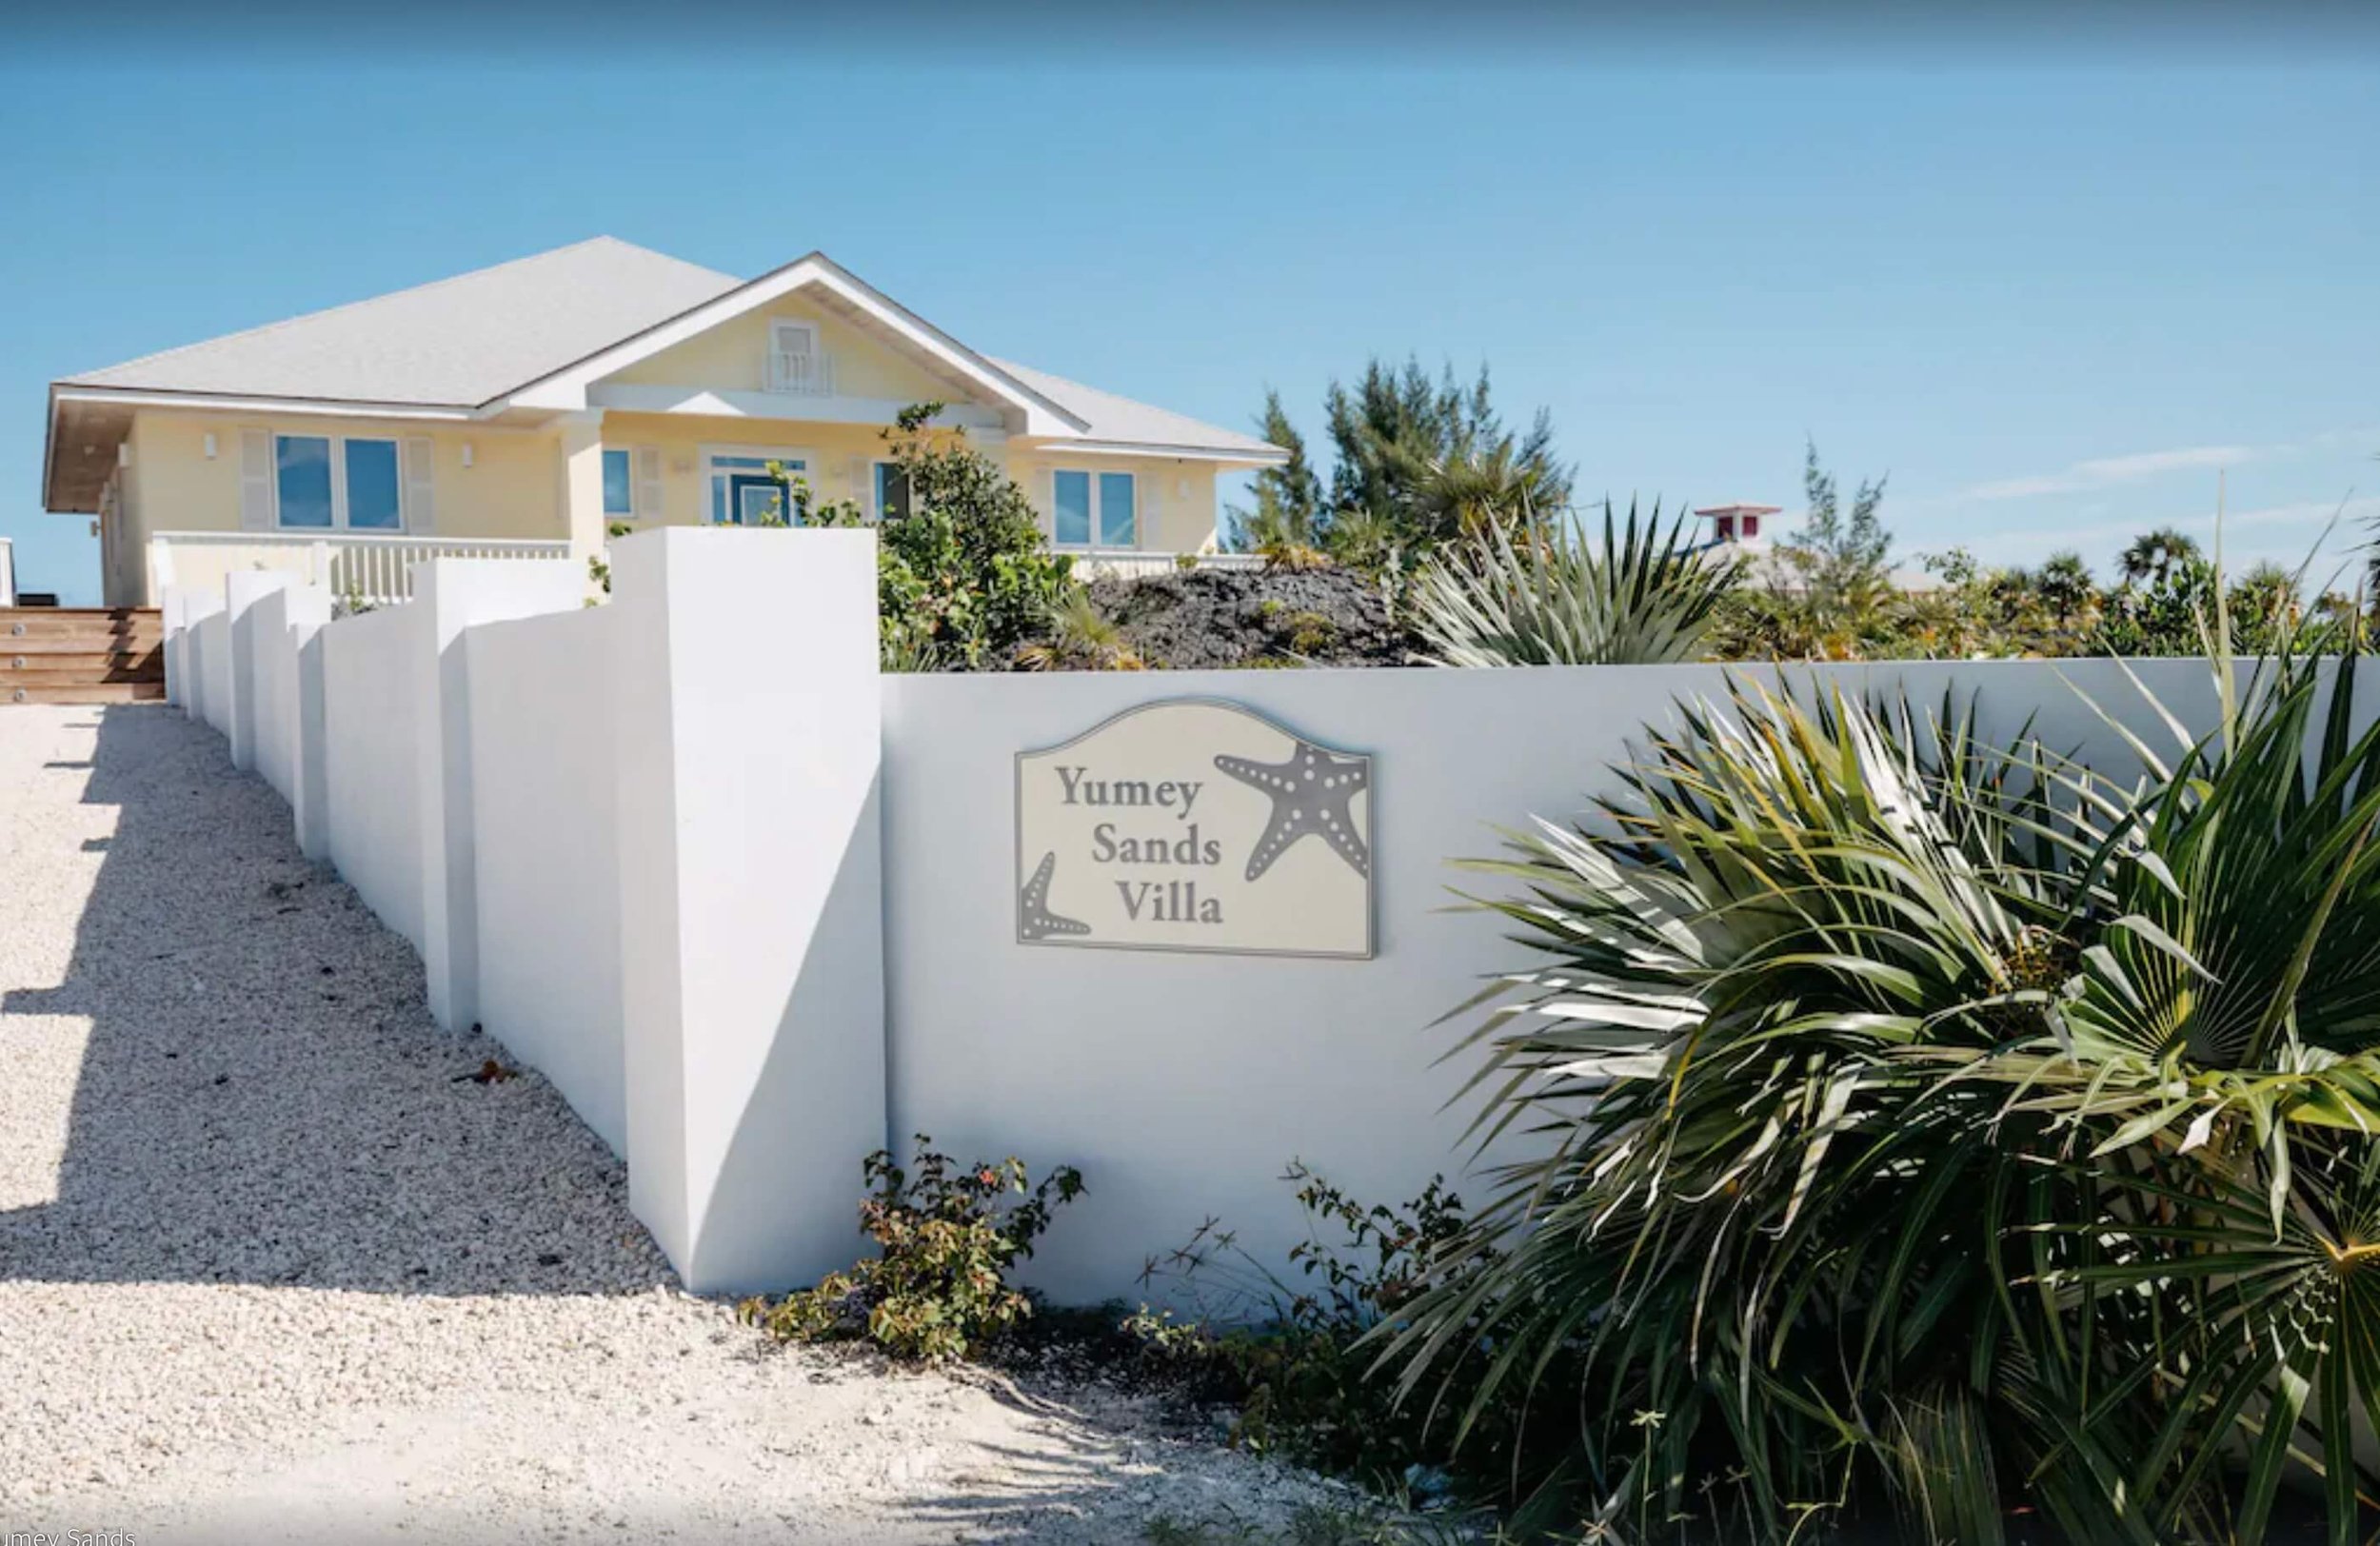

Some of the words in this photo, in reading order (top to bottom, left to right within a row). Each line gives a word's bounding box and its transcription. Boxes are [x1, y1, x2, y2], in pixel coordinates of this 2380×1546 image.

[1054, 765, 1203, 820] Yumey
[1092, 823, 1222, 866] Sands
[1116, 881, 1224, 923] Villa
